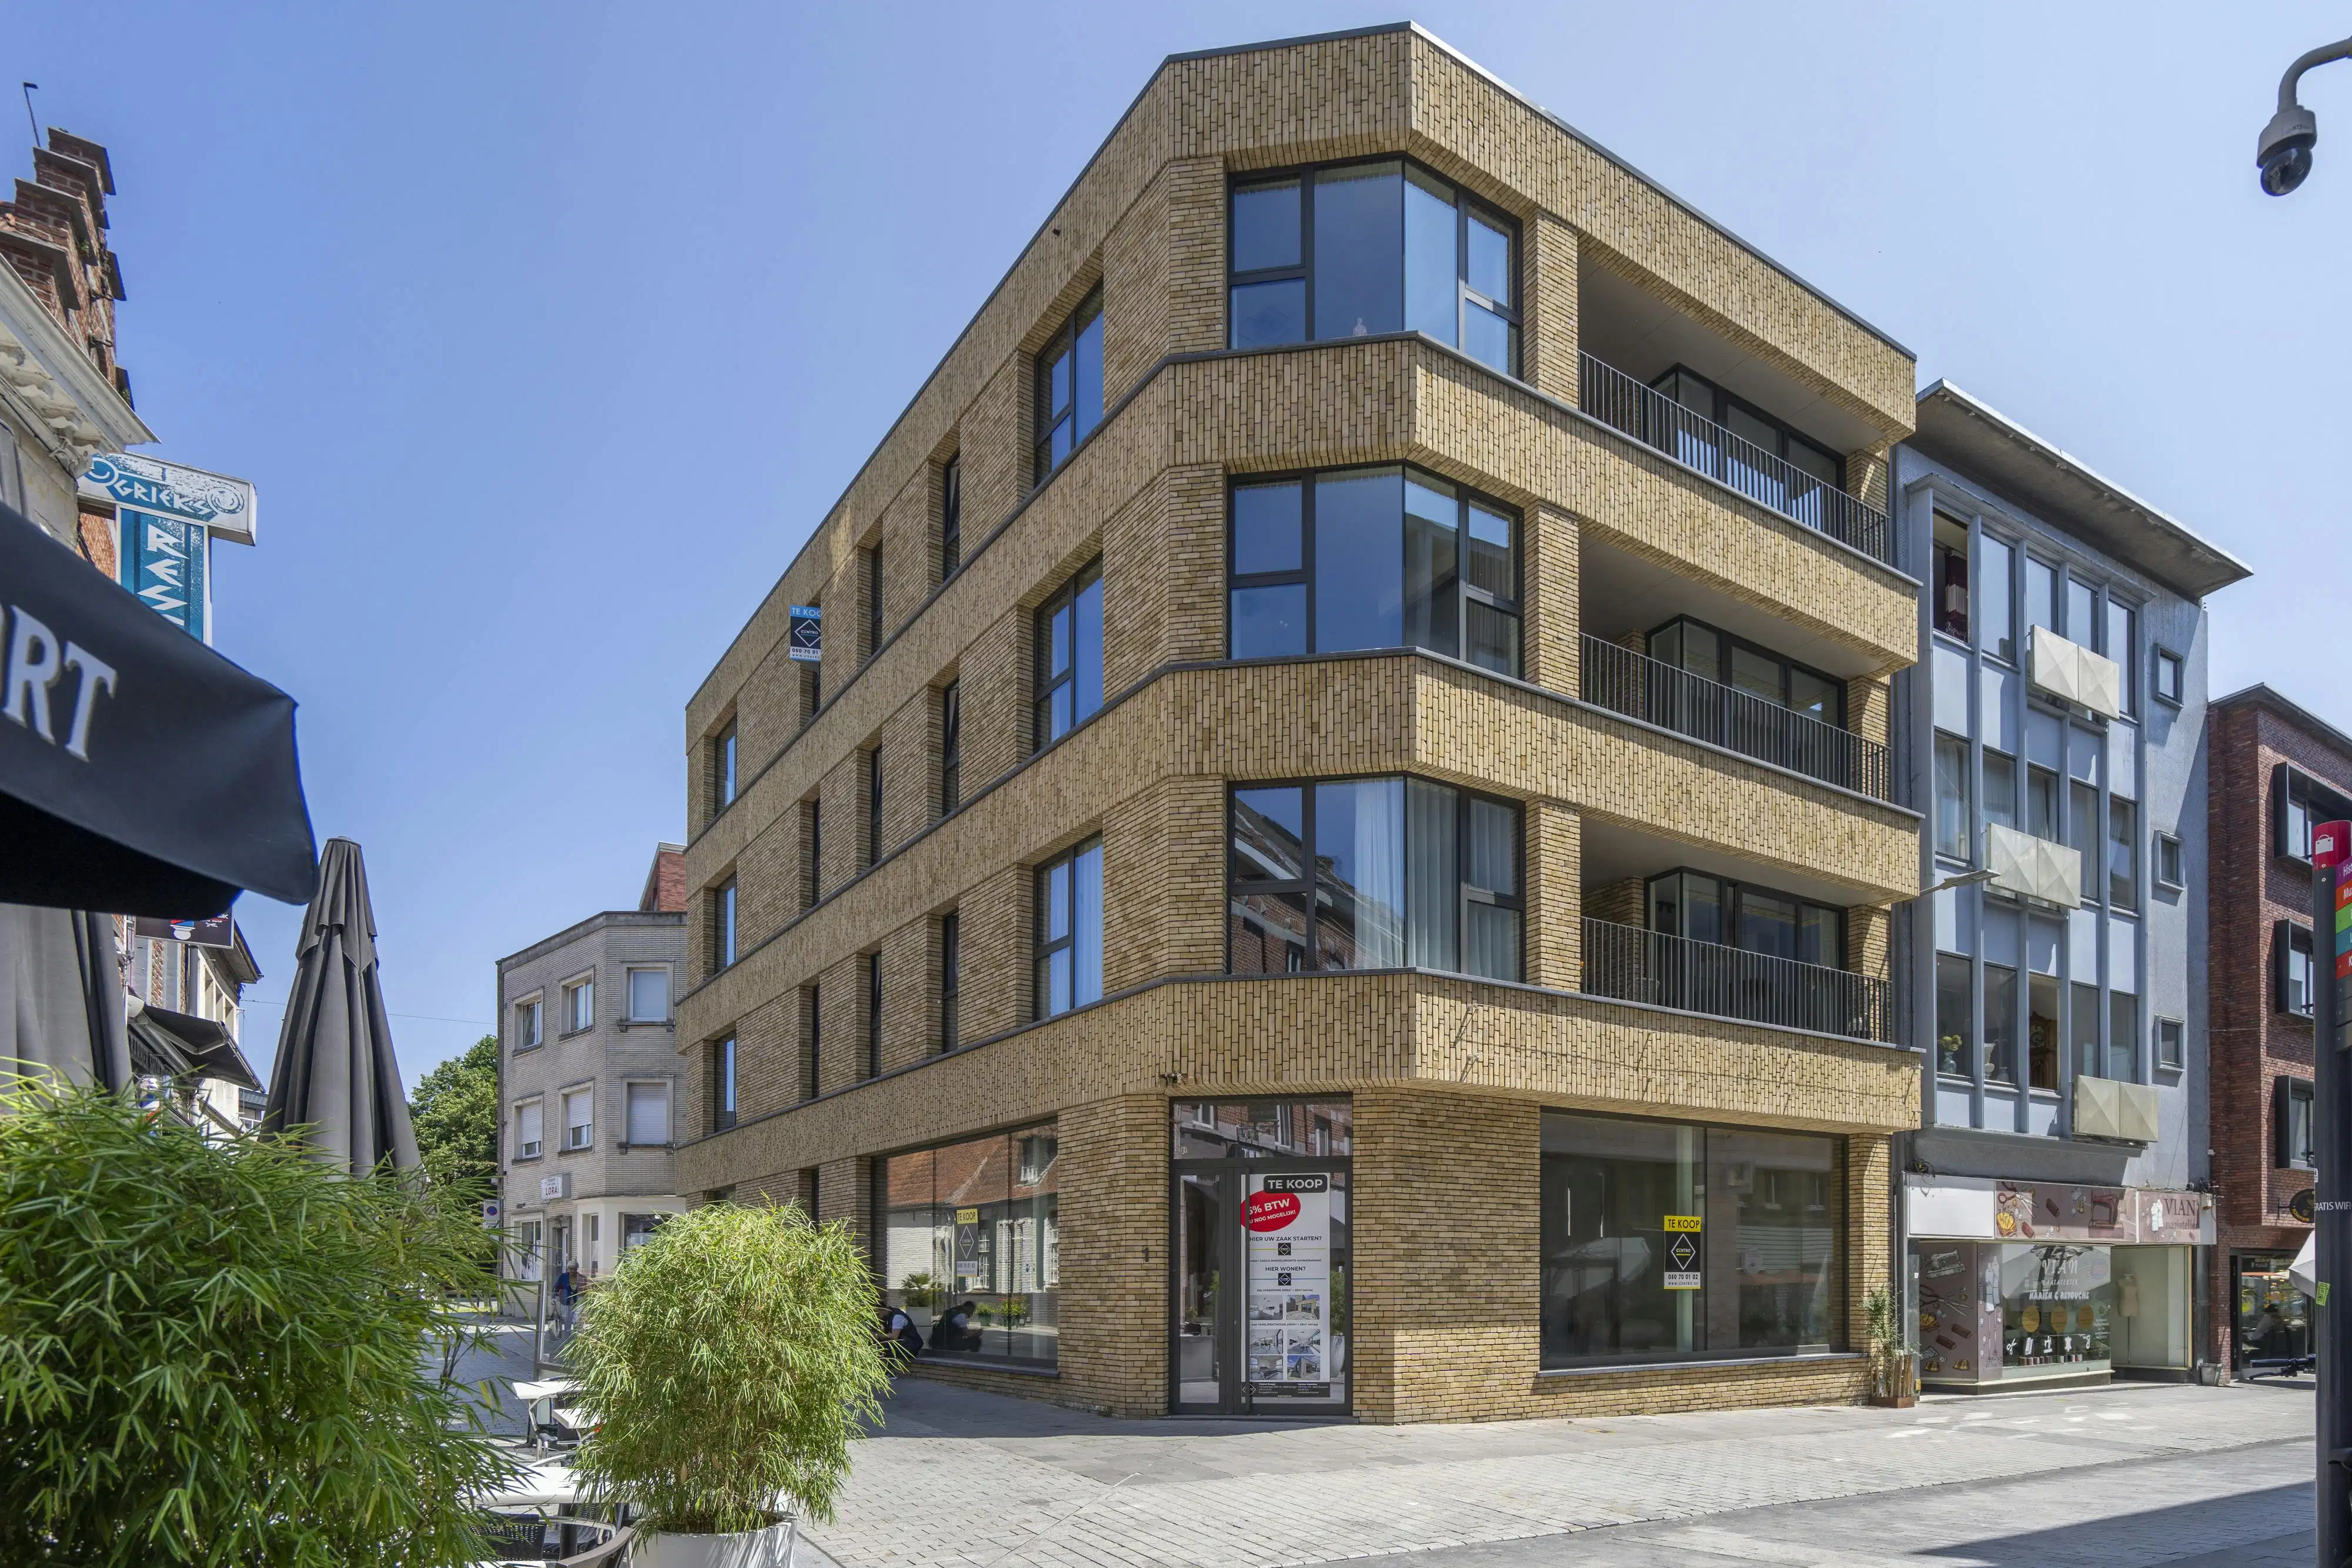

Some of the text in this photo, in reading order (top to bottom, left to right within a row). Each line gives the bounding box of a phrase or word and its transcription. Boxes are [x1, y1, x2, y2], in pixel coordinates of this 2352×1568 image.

[113, 479, 212, 515] GRIEKS
[0, 604, 118, 763] RT
[1268, 1179, 1323, 1189] TE KOOP
[1264, 1198, 1289, 1212] BTW
[2164, 1198, 2196, 1216] VIAN
[2334, 1201, 2351, 1210] WIFI
[963, 1212, 975, 1221] KOOP
[1267, 1210, 1296, 1221] MOGELIJK!
[1668, 1219, 1700, 1229] TE KOOP
[2042, 1259, 2078, 1274] VIAN
